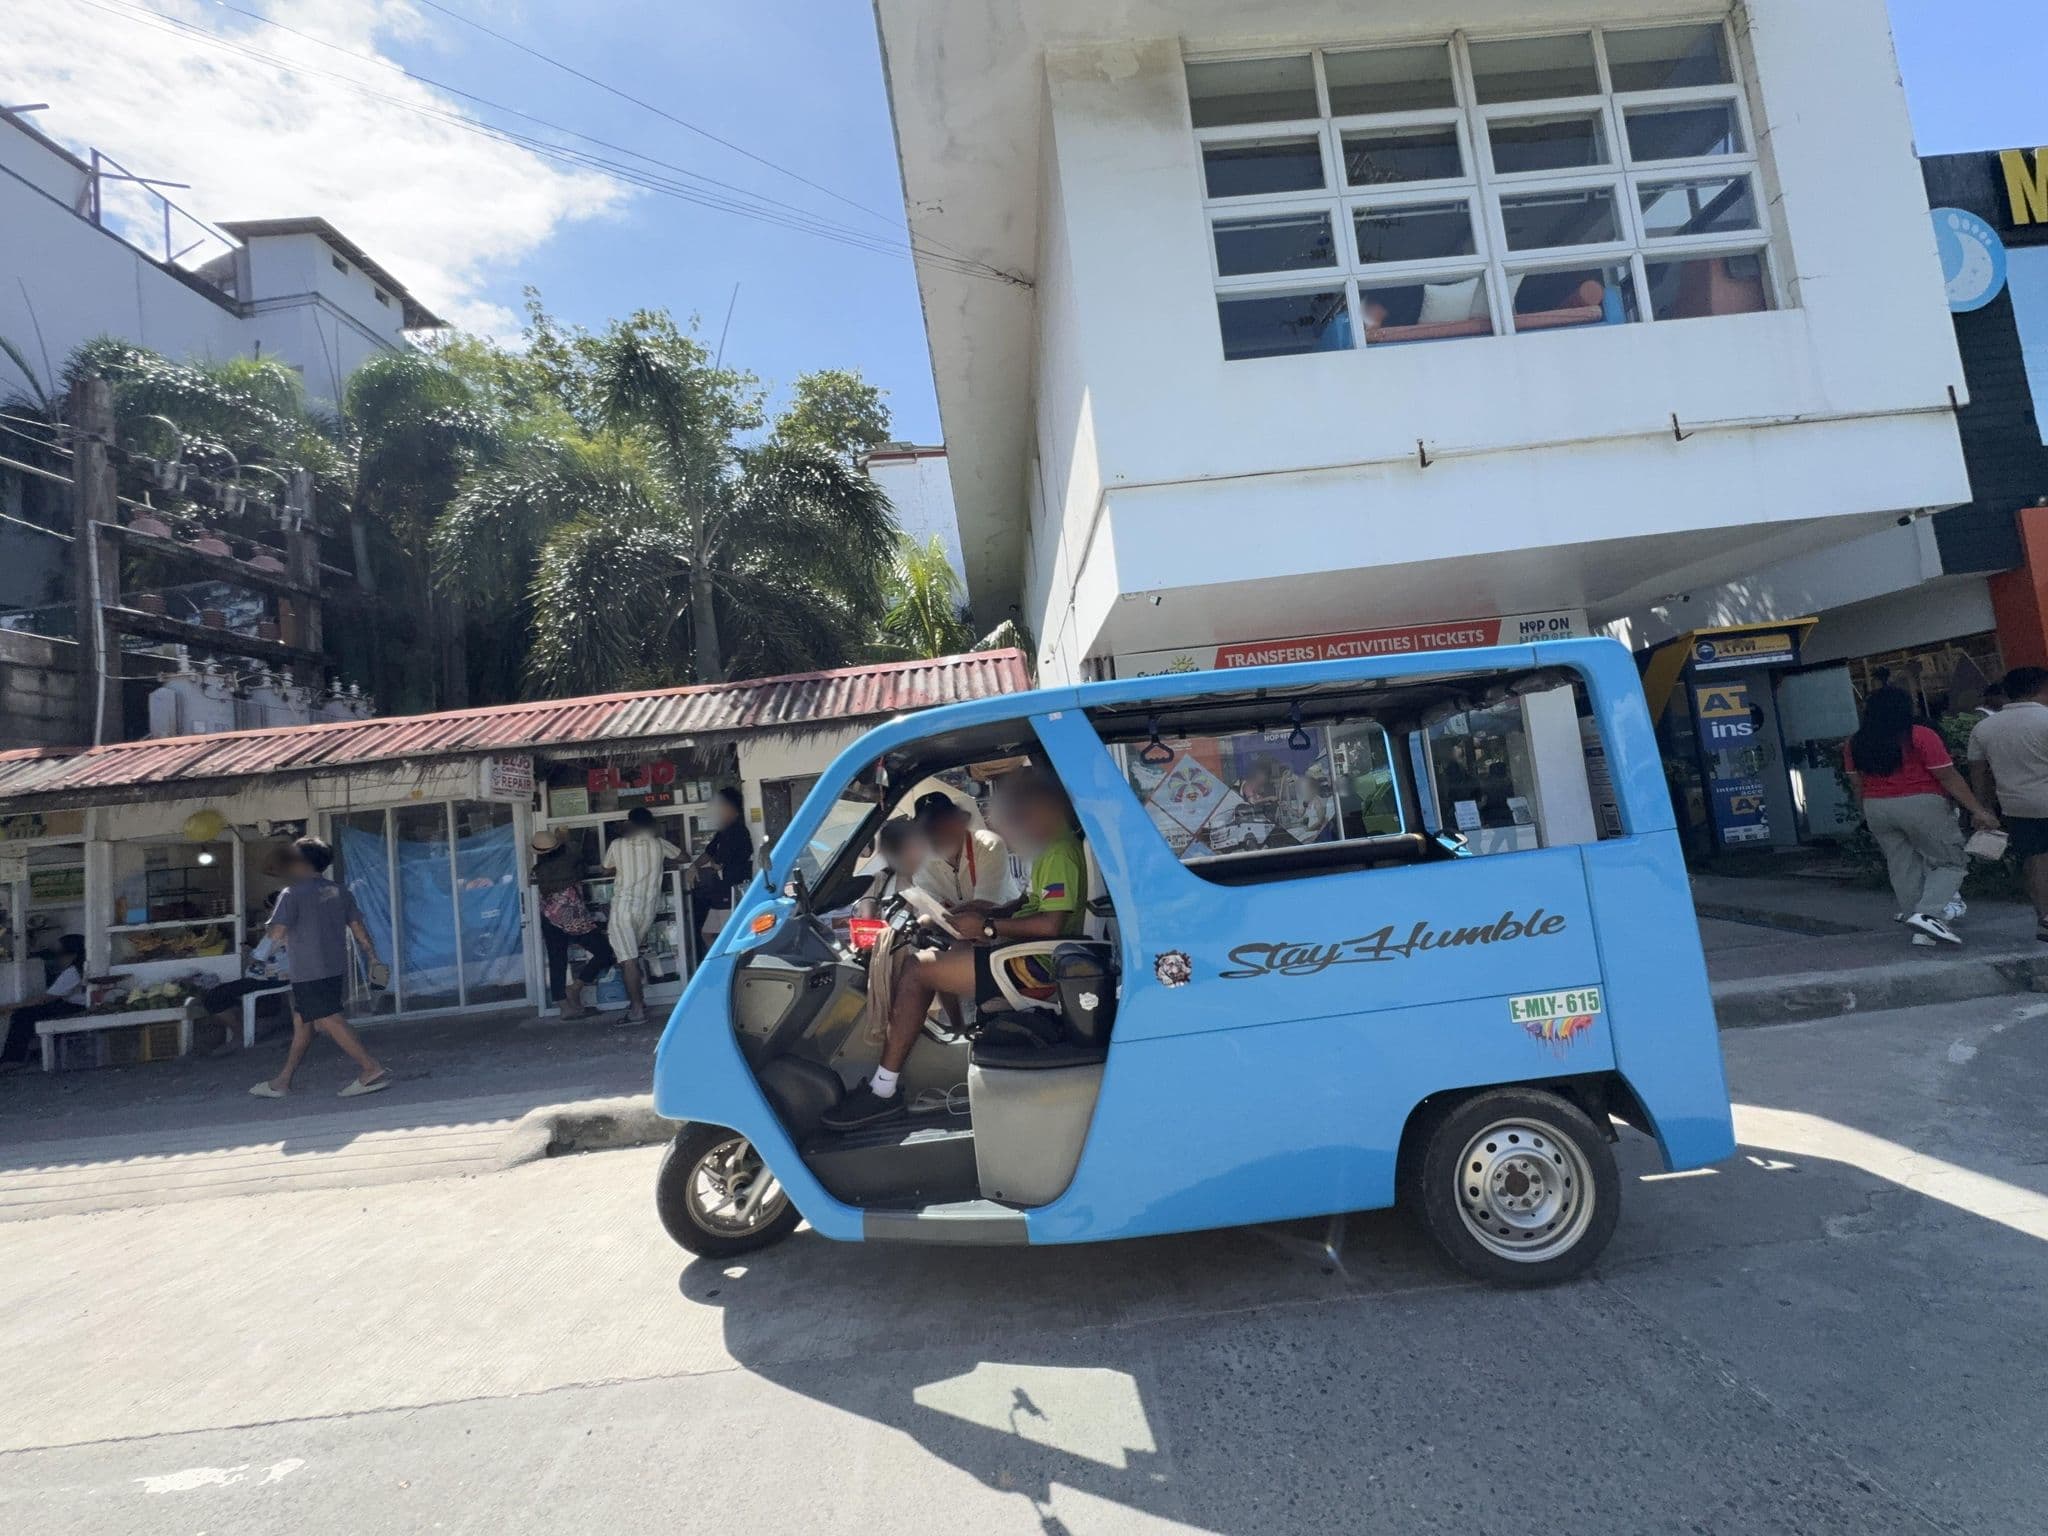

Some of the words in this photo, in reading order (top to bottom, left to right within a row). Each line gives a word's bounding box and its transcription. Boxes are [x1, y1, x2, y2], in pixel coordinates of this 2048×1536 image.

[1520, 620, 1546, 634] HOP
[1548, 617, 1569, 632] ON
[1225, 646, 1315, 667] TRANSFERS
[1326, 637, 1411, 657] ACTIVITIES
[1421, 629, 1485, 648] TICKETS
[588, 761, 677, 793] ELJO
[1219, 942, 1346, 979] Stay
[1341, 908, 1567, 959] Humble
